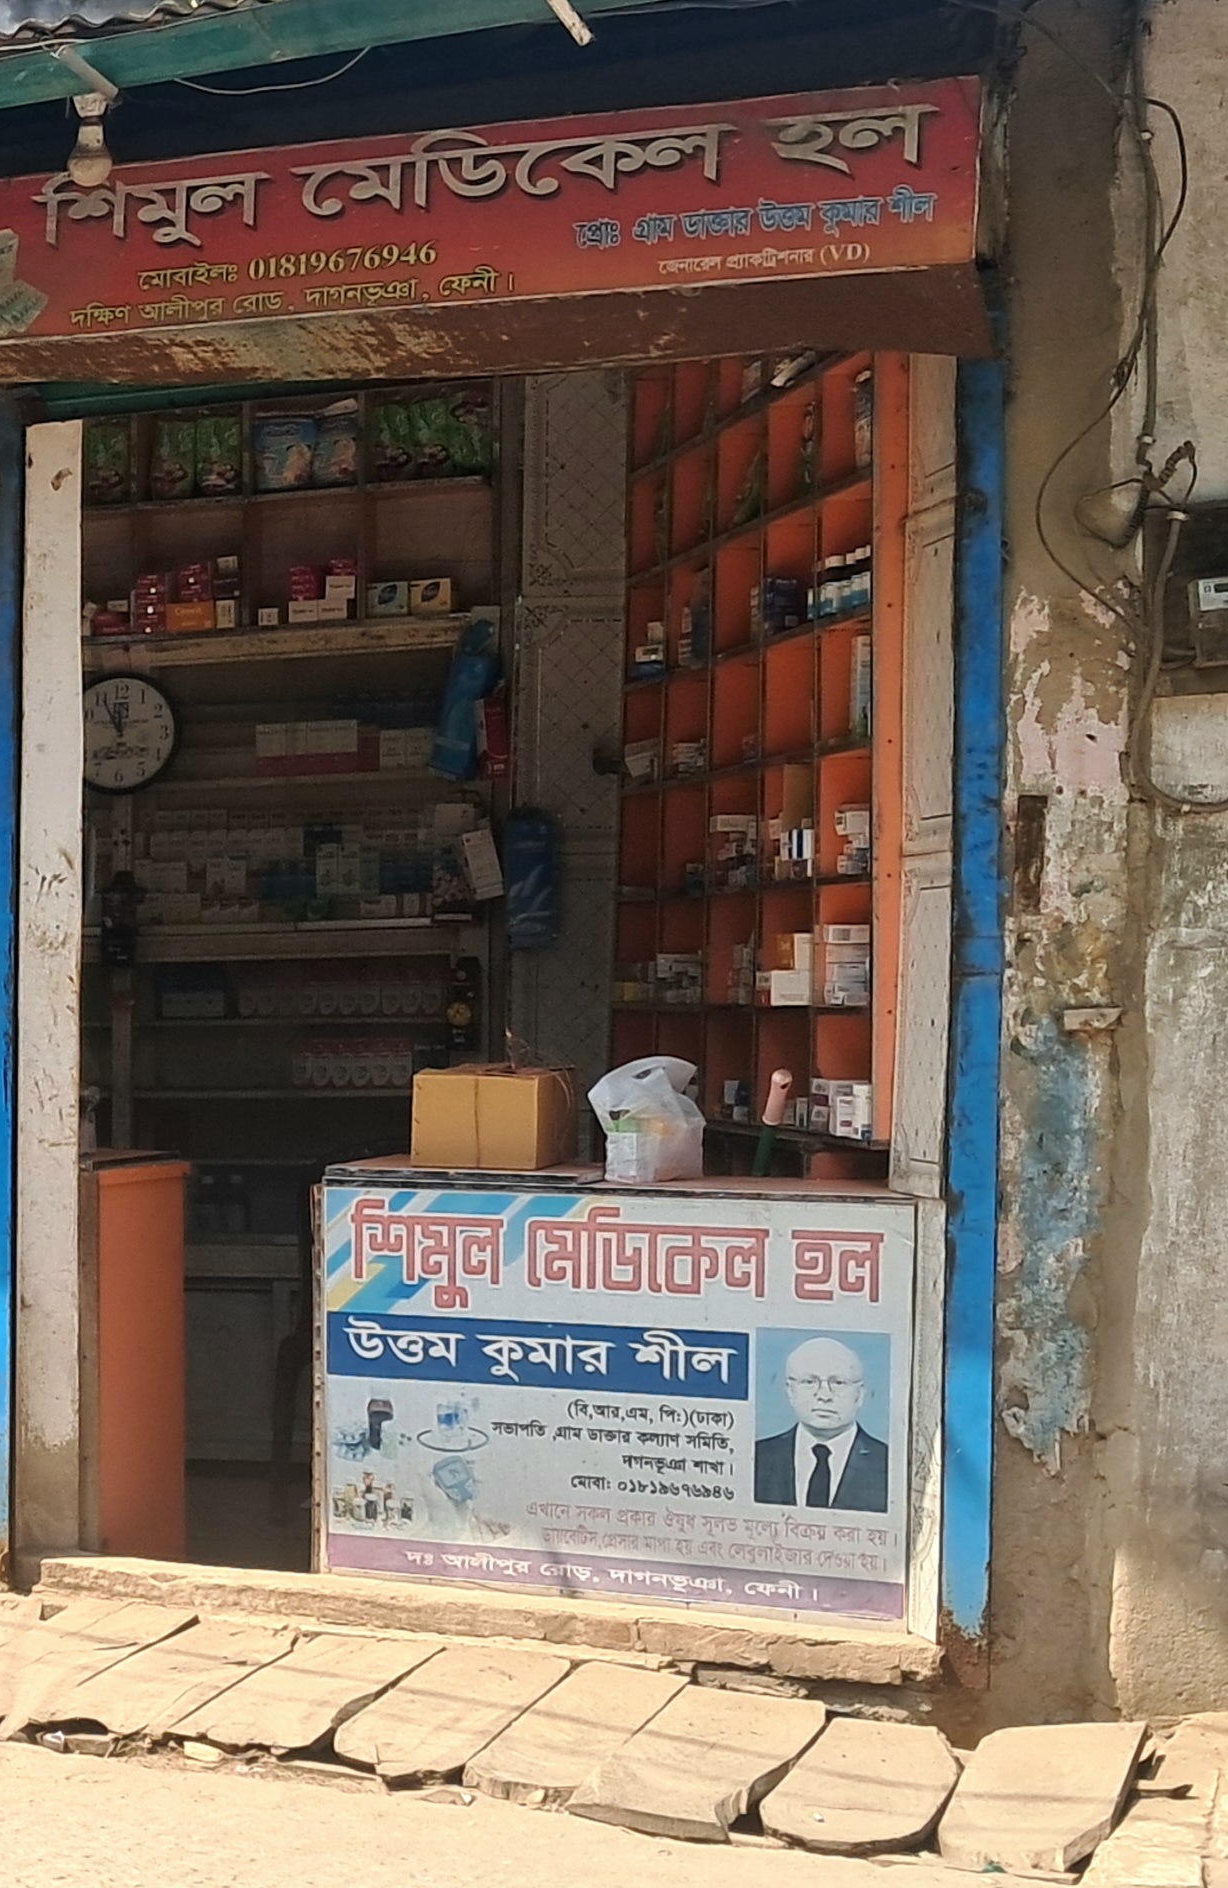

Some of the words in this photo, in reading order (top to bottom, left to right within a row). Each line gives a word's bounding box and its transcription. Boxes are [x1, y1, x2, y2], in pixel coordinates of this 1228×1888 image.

[31, 170, 272, 248] শিমুল
[290, 122, 738, 217] মেডিকেল
[767, 103, 941, 176] হল
[631, 213, 676, 246] গ্রাম
[682, 206, 752, 240] ডাক্তার
[757, 195, 814, 233] উত্তম
[818, 195, 883, 239] কুমার
[888, 184, 938, 224] শীল
[137, 262, 239, 292] মোবাইলঃ
[248, 240, 438, 281] 01819676946
[819, 242, 871, 266] (VD)
[70, 303, 131, 330] দক্ষিণ
[138, 293, 225, 324] আলীপুর
[114, 684, 130, 700] 12
[350, 1198, 505, 1310] শিমুল
[526, 1206, 771, 1299] মেডিকেল
[790, 1229, 886, 1304] হল
[342, 1316, 467, 1368] উত্তম
[477, 1330, 617, 1383] কুমার
[628, 1328, 740, 1385] শীল
[491, 1419, 548, 1438] সভাপতি
[587, 1428, 631, 1445] ডাক্তার
[636, 1430, 680, 1449] কল্যাণ
[617, 1480, 735, 1501] ০১৮১৯৬৭৬৯৪৬
[526, 1501, 570, 1520] এখানে
[574, 1505, 612, 1523] সকল
[616, 1507, 657, 1527] প্রকার
[784, 1515, 827, 1541] বিক্রয়
[833, 1526, 861, 1544] করা
[440, 1551, 532, 1577] আলীপুর
[643, 1535, 671, 1554] মাপা
[674, 1538, 693, 1557] হয়
[697, 1541, 724, 1559] এবং
